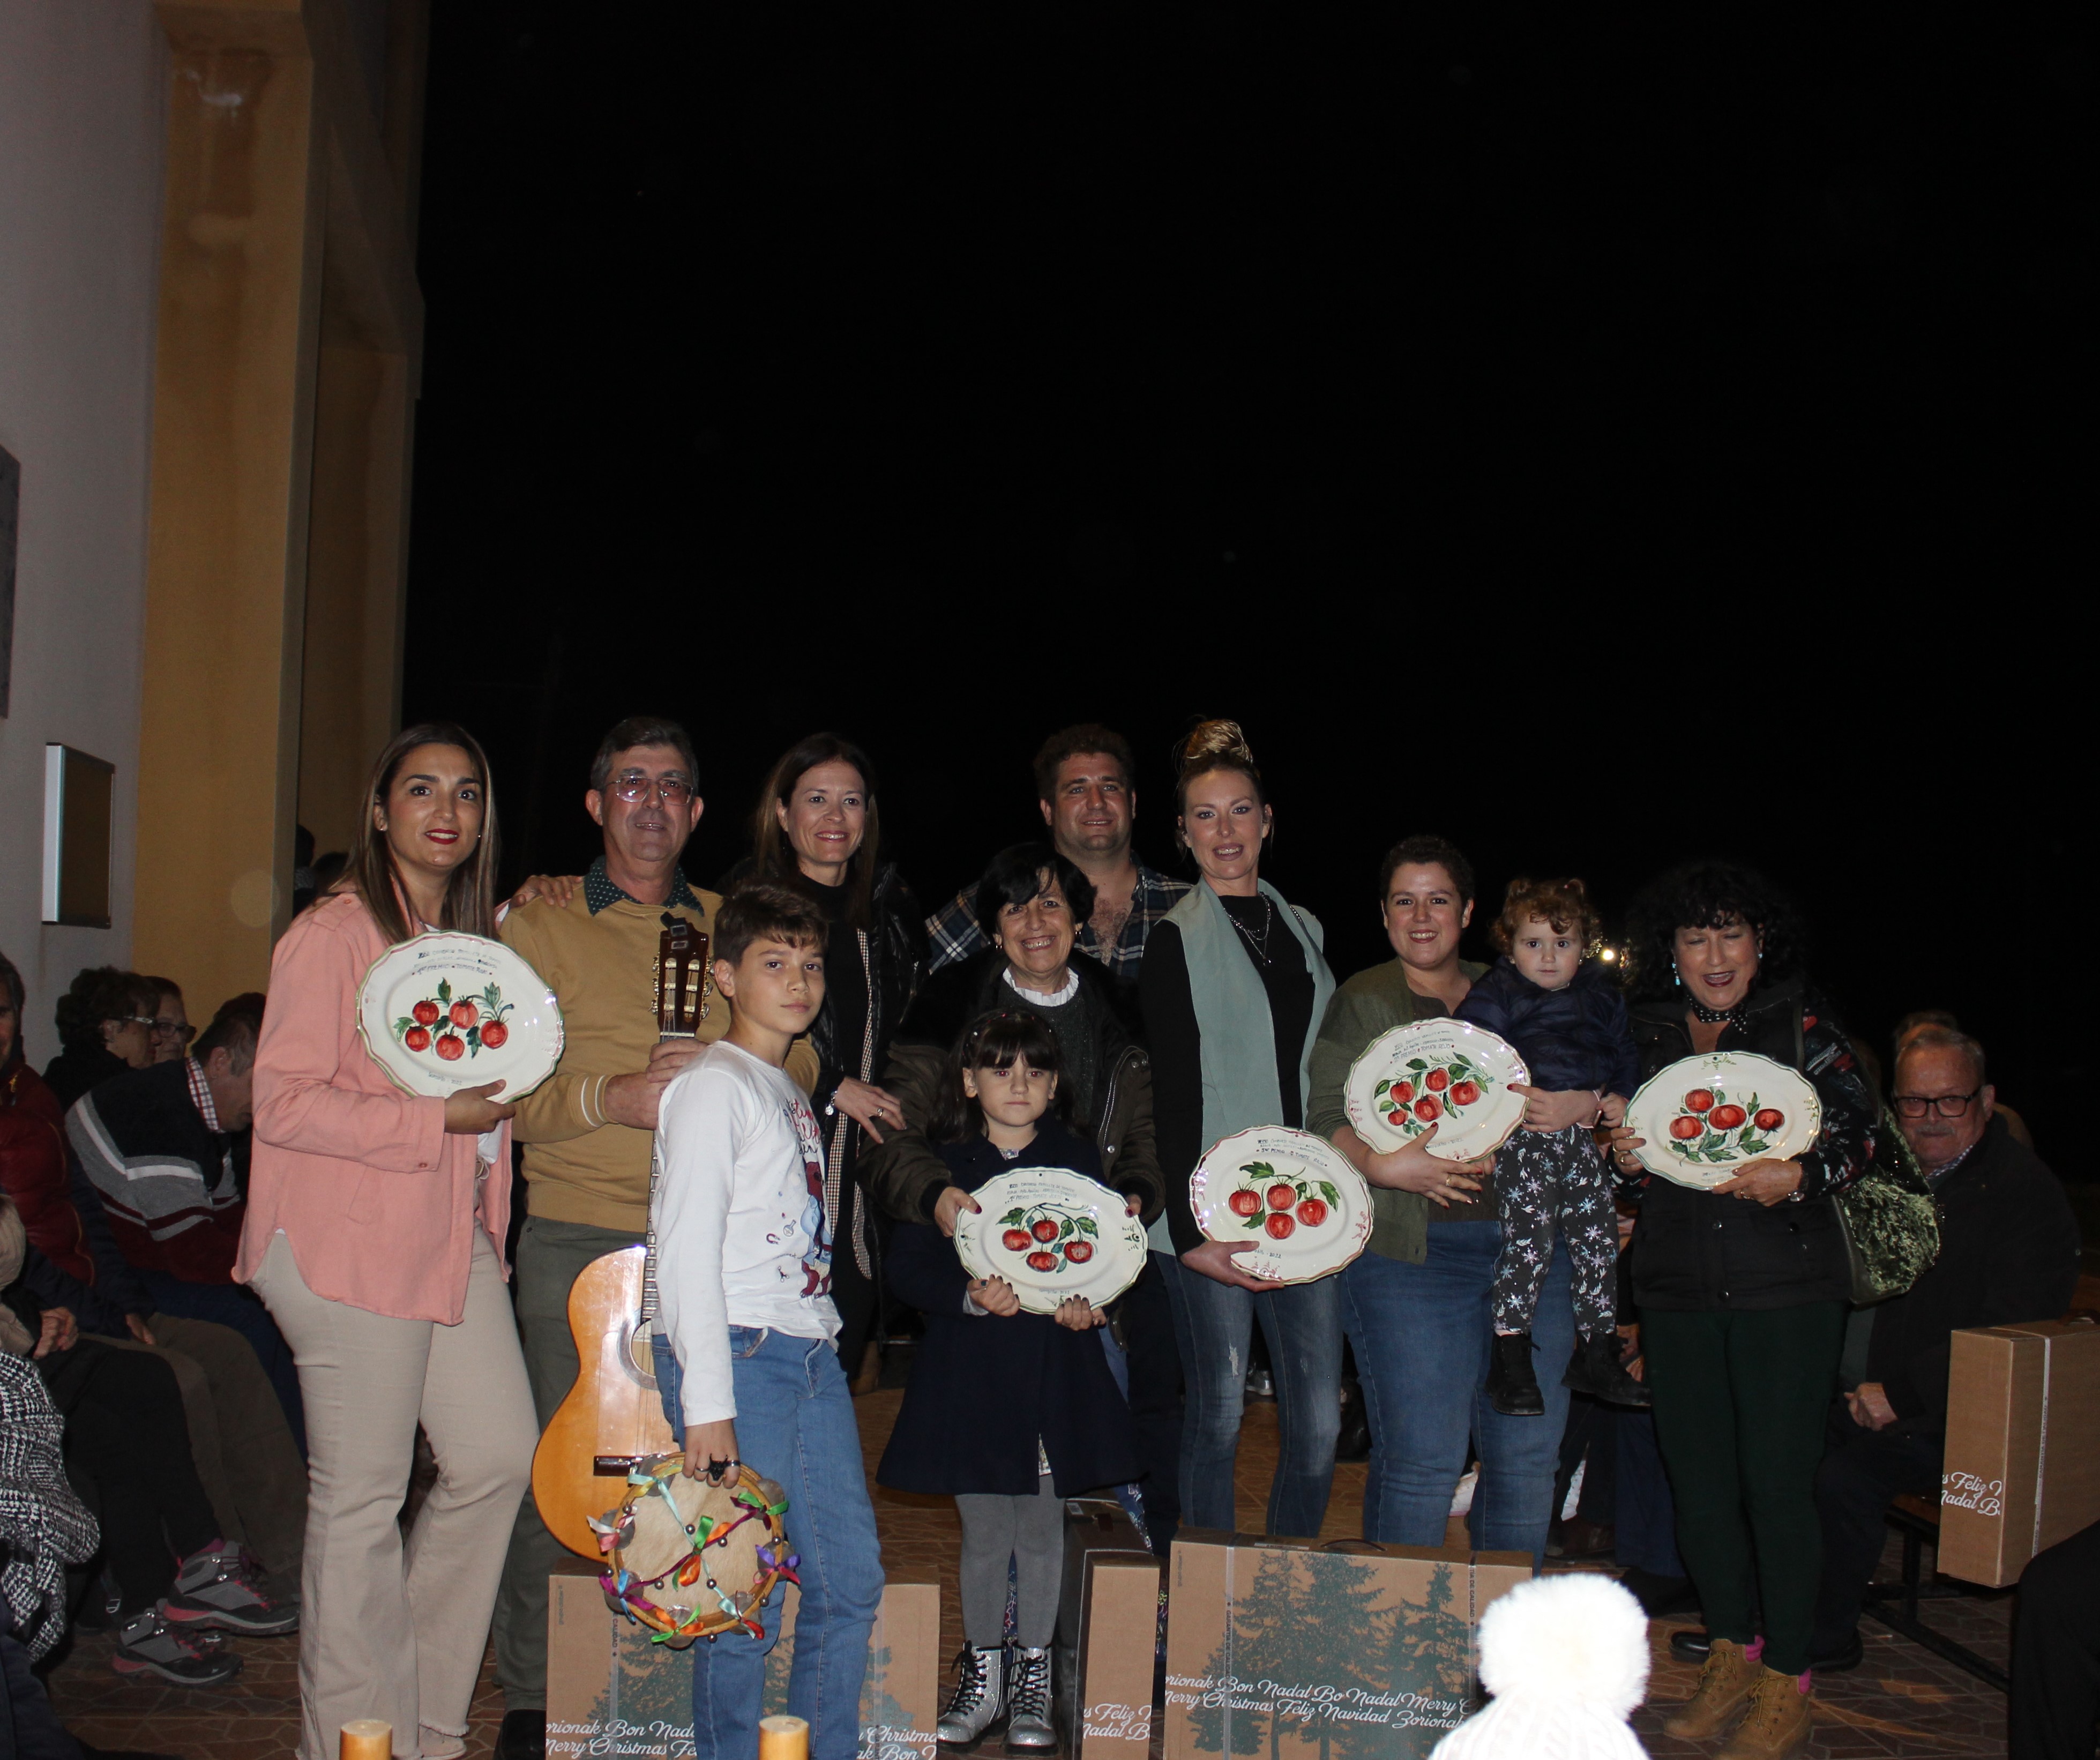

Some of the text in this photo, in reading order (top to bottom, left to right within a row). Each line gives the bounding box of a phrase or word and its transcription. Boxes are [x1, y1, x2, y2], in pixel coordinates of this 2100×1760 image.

[1295, 1152, 1310, 1160] TOMATE
[1951, 1472, 1987, 1499] Feliz
[1469, 1579, 1475, 1589] DE
[1225, 1642, 1231, 1650] DE
[1203, 1691, 1274, 1712] Christmas
[1276, 1698, 1316, 1722] Feliz
[1318, 1703, 1392, 1723] Navidad
[1215, 1676, 1255, 1692] Bon
[1258, 1679, 1313, 1698] Nadal
[1311, 1685, 1346, 1703] Bo
[1346, 1688, 1402, 1707] Nadal
[1401, 1692, 1457, 1717] Merry
[1095, 1703, 1135, 1726] Feliz
[602, 1719, 646, 1738] Bon
[649, 1720, 695, 1741] Nad
[589, 1737, 667, 1755] Christmas
[670, 1740, 697, 1758] Fe
[878, 1744, 918, 1760] Bon
